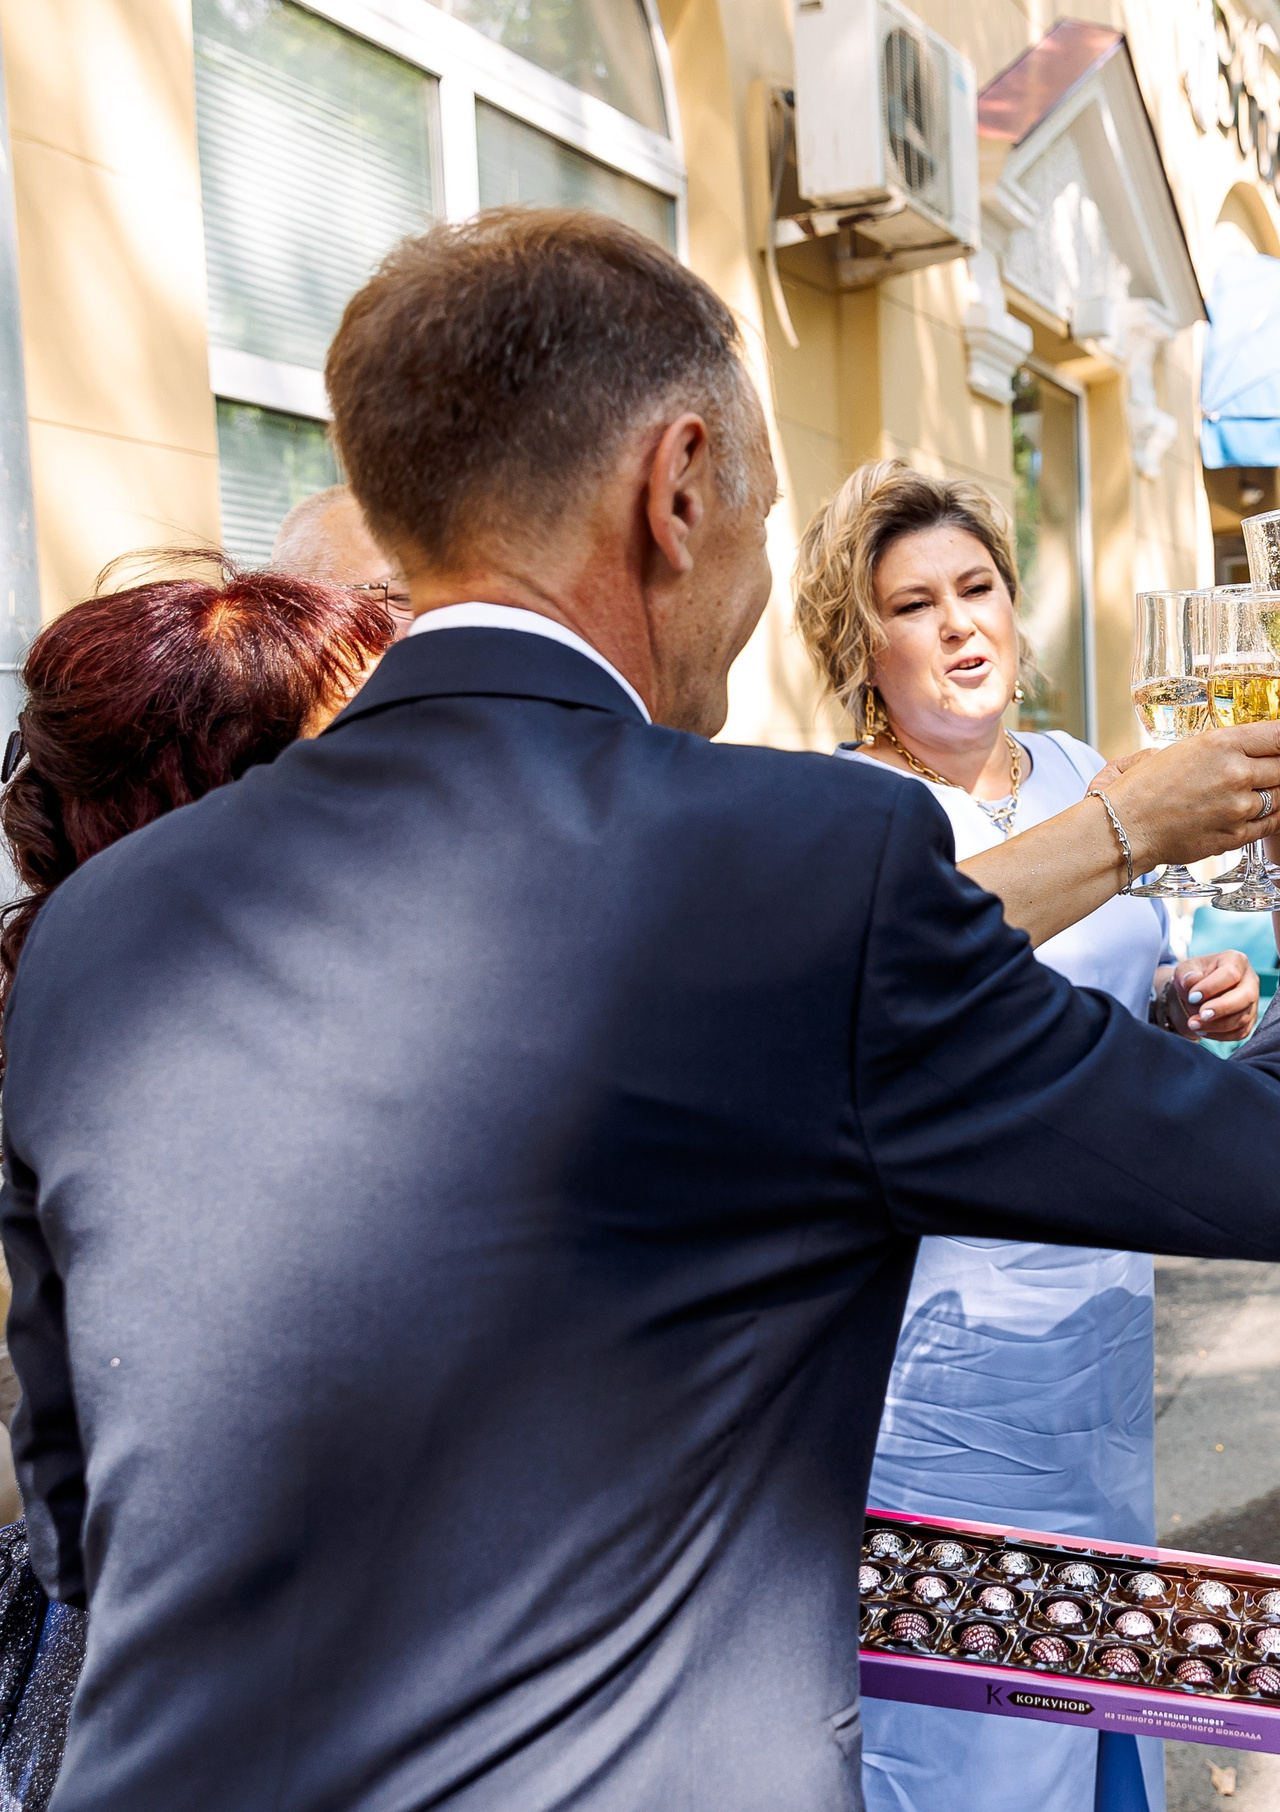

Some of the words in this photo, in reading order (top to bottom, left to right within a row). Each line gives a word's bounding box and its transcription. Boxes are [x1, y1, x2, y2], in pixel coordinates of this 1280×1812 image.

[1104, 1711, 1115, 1719] ИЗ
[1117, 1712, 1154, 1725] ТЕМНОГО
[1163, 1720, 1214, 1734] МОЛОЧНОГО
[1216, 1727, 1262, 1740] ШОКОЛАДА
[1142, 1709, 1190, 1721] КОЛЛЕКЦИЯ
[1192, 1716, 1225, 1727] КОНФЕТ
